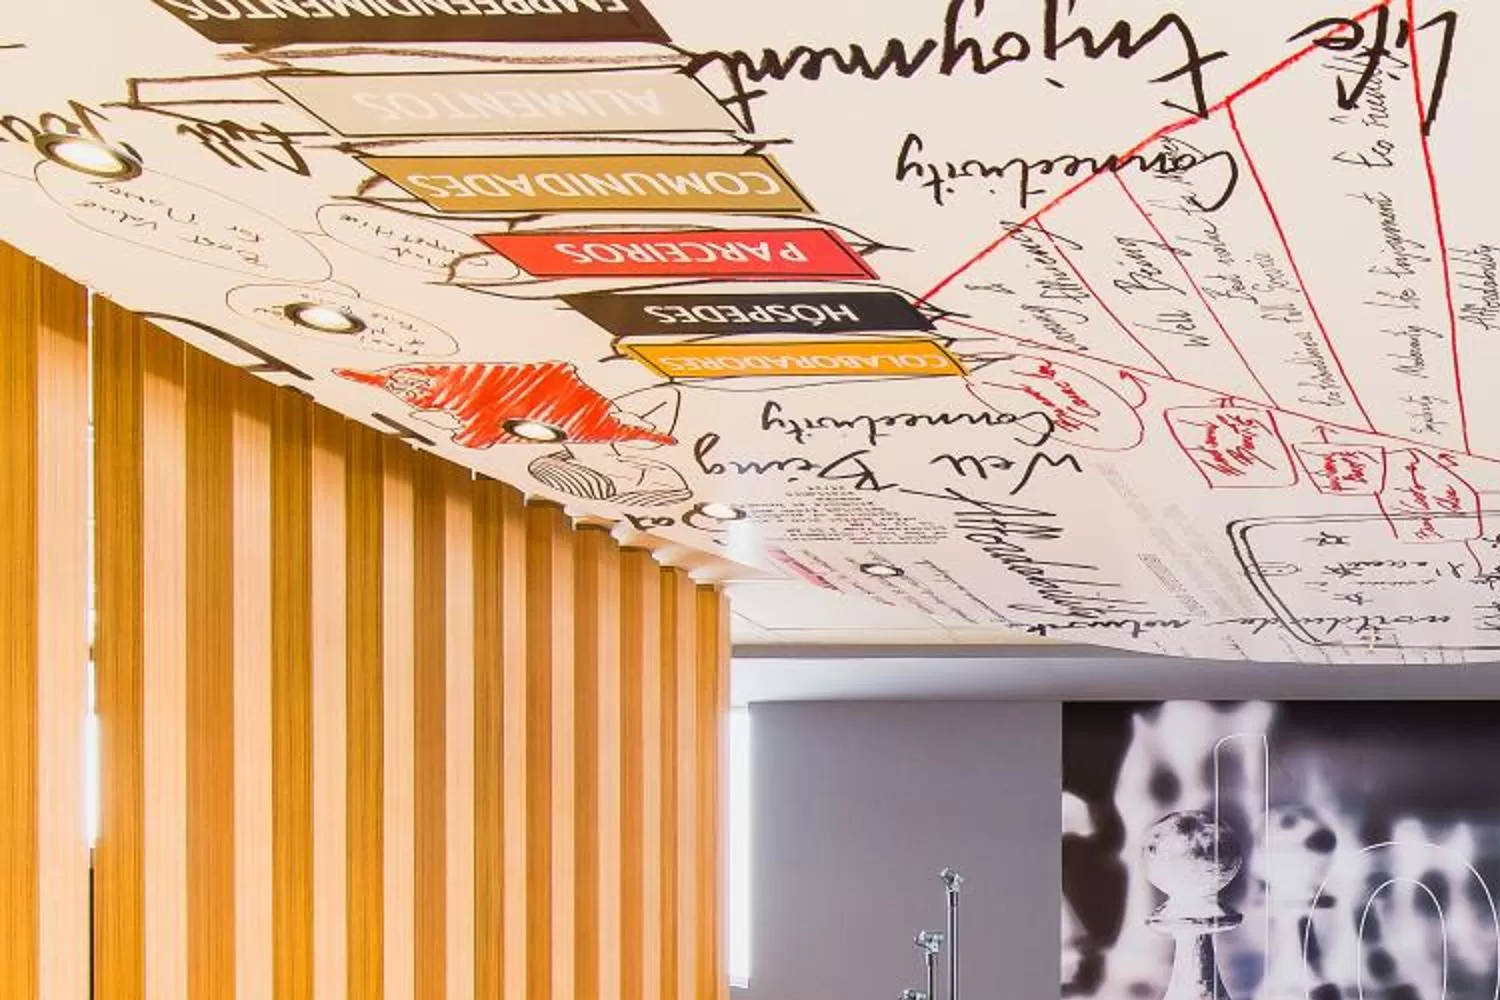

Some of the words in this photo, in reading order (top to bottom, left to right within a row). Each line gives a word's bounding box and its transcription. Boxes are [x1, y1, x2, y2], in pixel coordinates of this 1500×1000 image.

[353, 84, 663, 122] ALIMENTOS
[407, 171, 780, 197] COMUNIDADES
[895, 134, 1238, 213] Connectivity
[552, 241, 808, 266] PARCEIROS
[643, 303, 860, 328] HÓSPEDES
[659, 353, 949, 373] COLABORADORES
[761, 401, 1055, 448] Connectivity
[692, 433, 899, 493] Being
[929, 451, 1082, 496] Well
